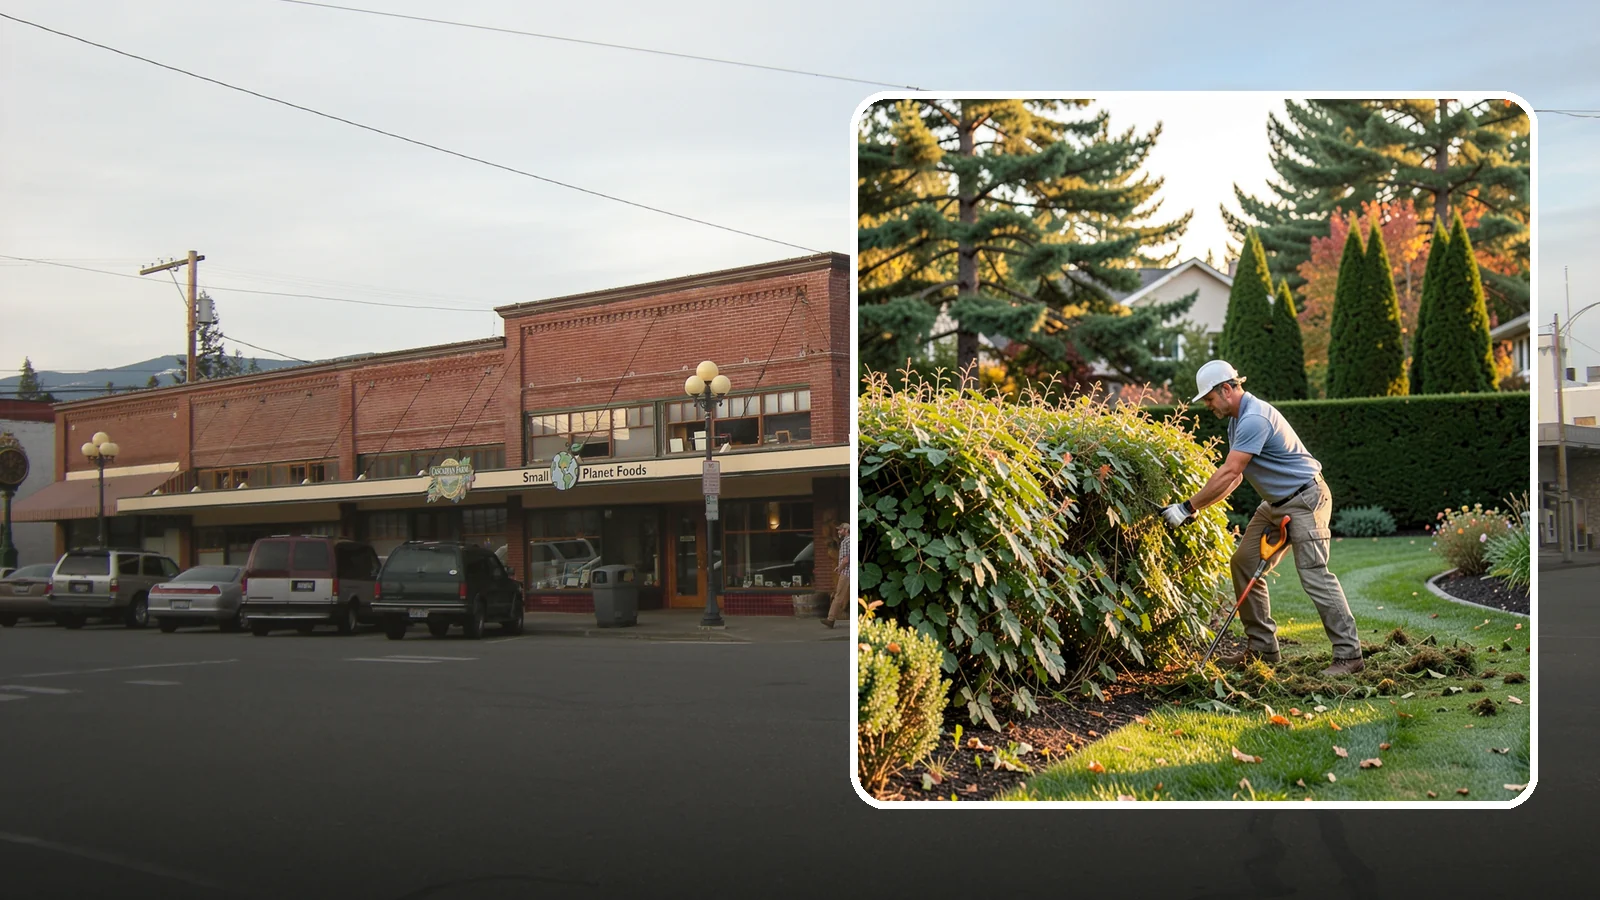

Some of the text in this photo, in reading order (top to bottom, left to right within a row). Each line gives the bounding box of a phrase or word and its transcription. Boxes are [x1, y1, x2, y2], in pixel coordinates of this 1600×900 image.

[523, 464, 647, 483] Small Planet Foods
